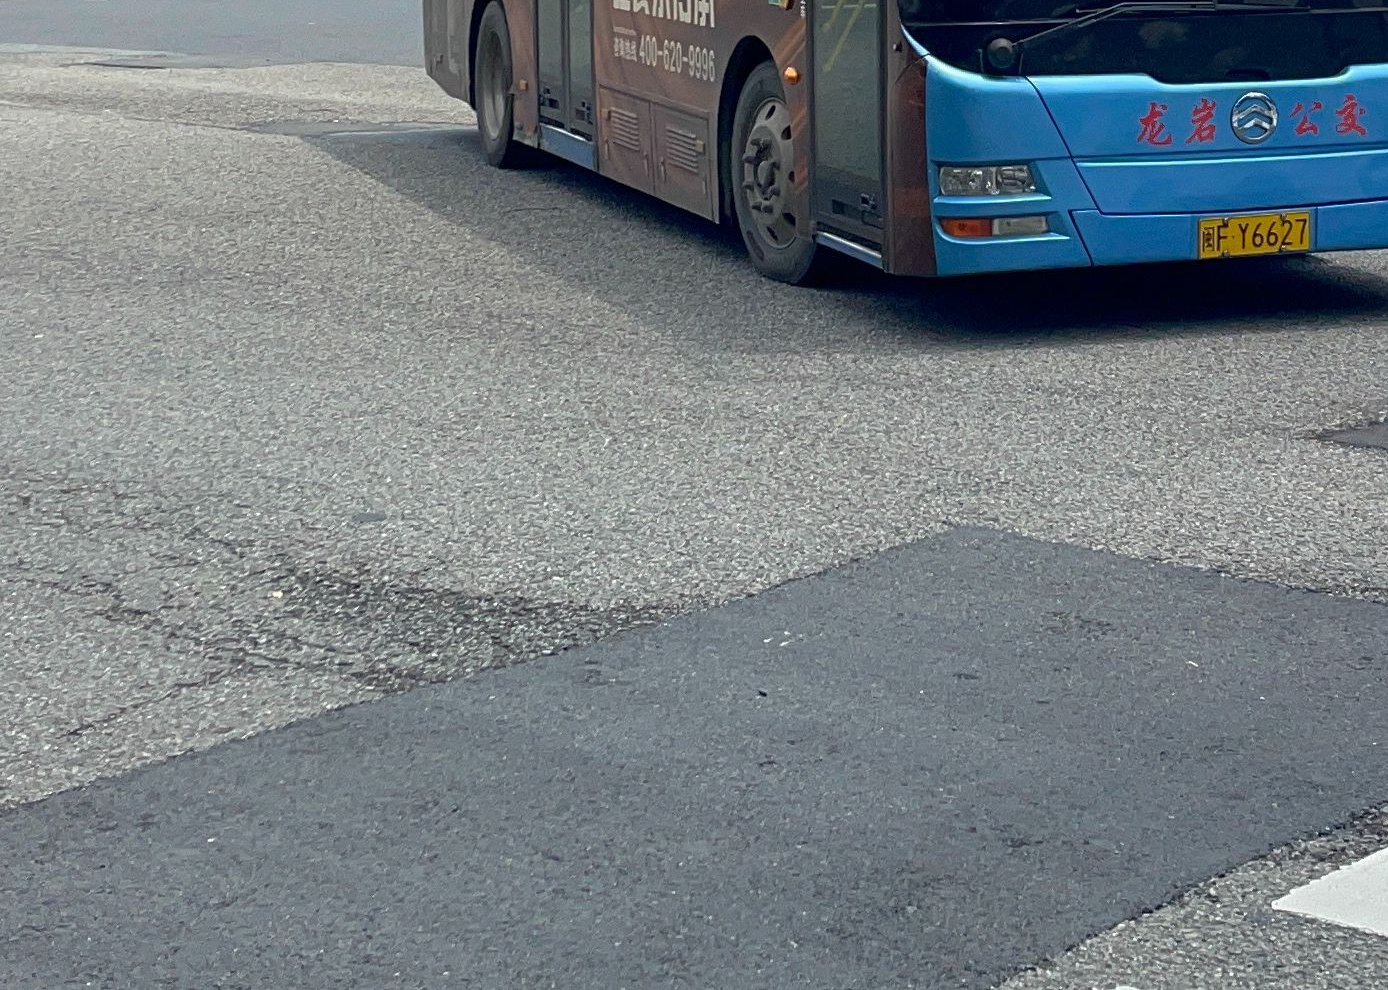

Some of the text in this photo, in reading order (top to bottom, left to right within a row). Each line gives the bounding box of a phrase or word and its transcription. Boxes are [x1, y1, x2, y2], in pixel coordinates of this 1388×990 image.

[639, 35, 715, 82] 400-620-9996
[1137, 93, 1368, 146] 龙岩 公交
